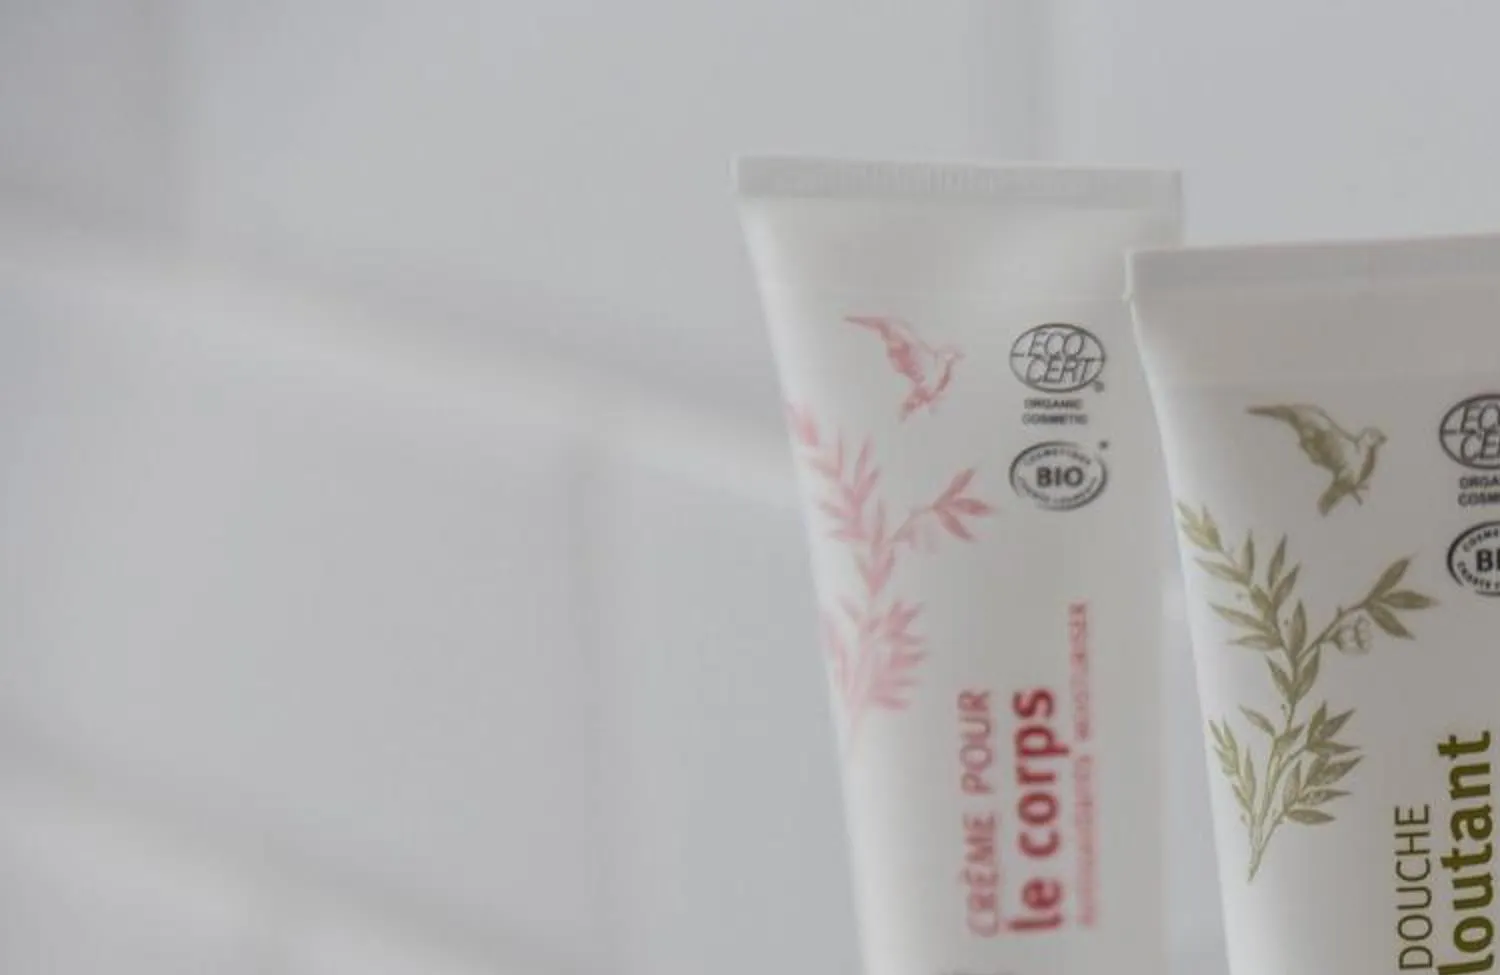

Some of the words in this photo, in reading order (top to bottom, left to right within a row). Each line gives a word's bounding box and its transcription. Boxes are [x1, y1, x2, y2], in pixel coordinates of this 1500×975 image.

[1025, 354, 1093, 384] CERT
[1028, 329, 1086, 358] ECO
[1036, 466, 1085, 488] BIO
[957, 686, 996, 796] POUR
[1013, 687, 1070, 860] corps
[956, 810, 1001, 938] CRÈME
[1004, 876, 1065, 934] le
[1393, 801, 1434, 971] DOUCHE
